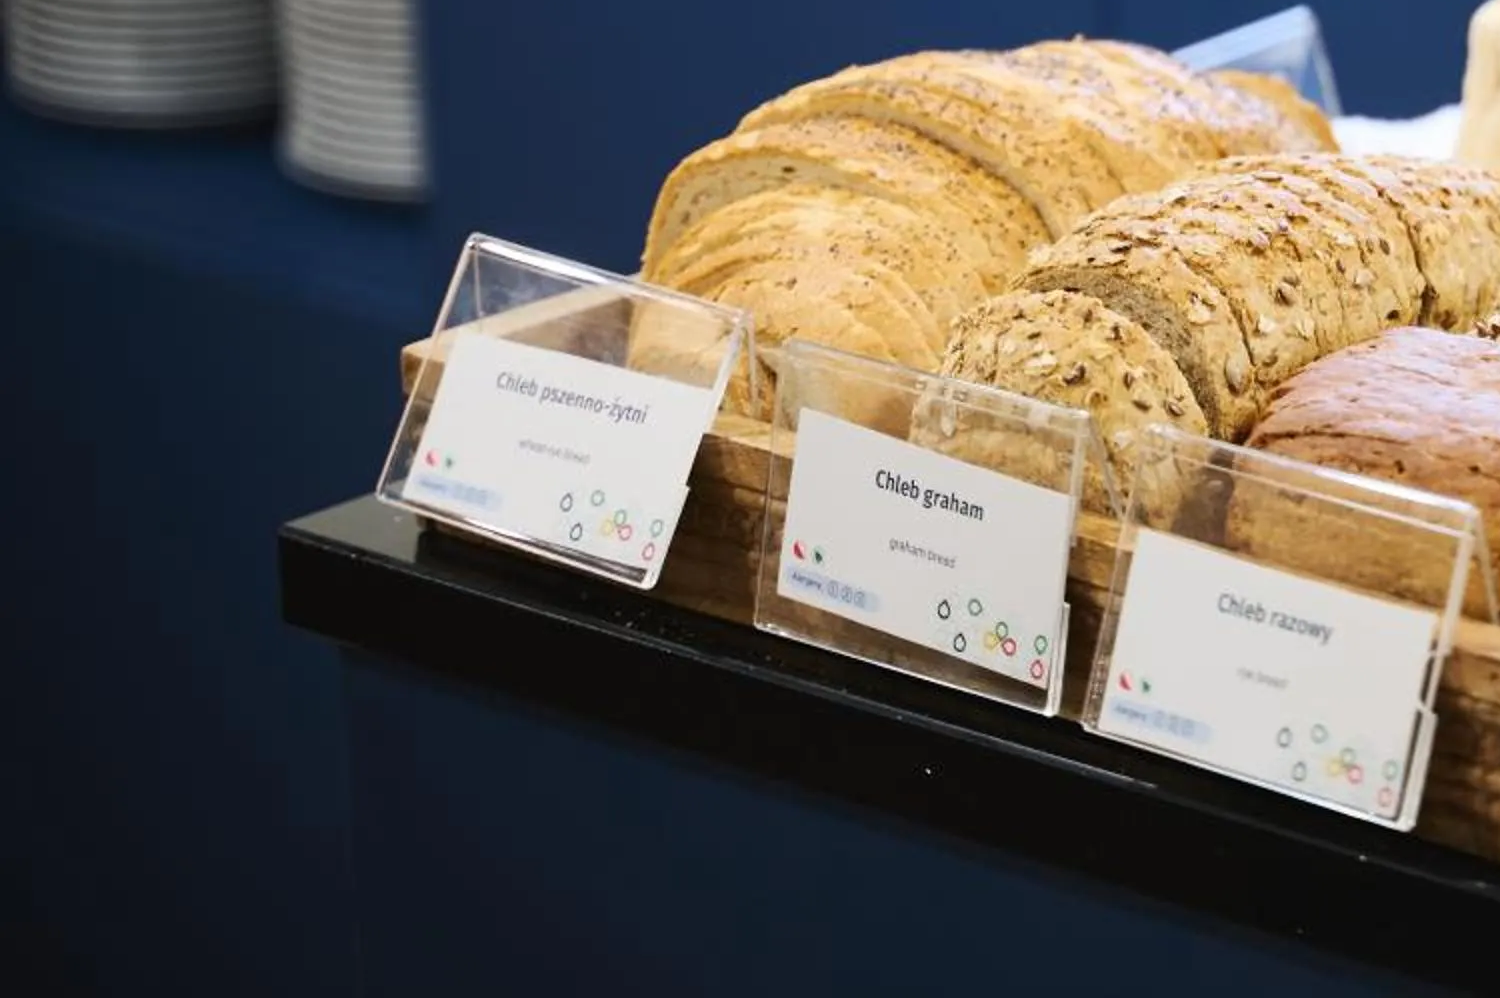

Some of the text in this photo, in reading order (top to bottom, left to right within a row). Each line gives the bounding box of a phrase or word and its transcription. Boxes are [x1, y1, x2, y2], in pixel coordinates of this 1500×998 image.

[496, 371, 539, 397] Chleb
[875, 469, 985, 521] Chleb graham
[1218, 593, 1334, 646] Chleb razowy
